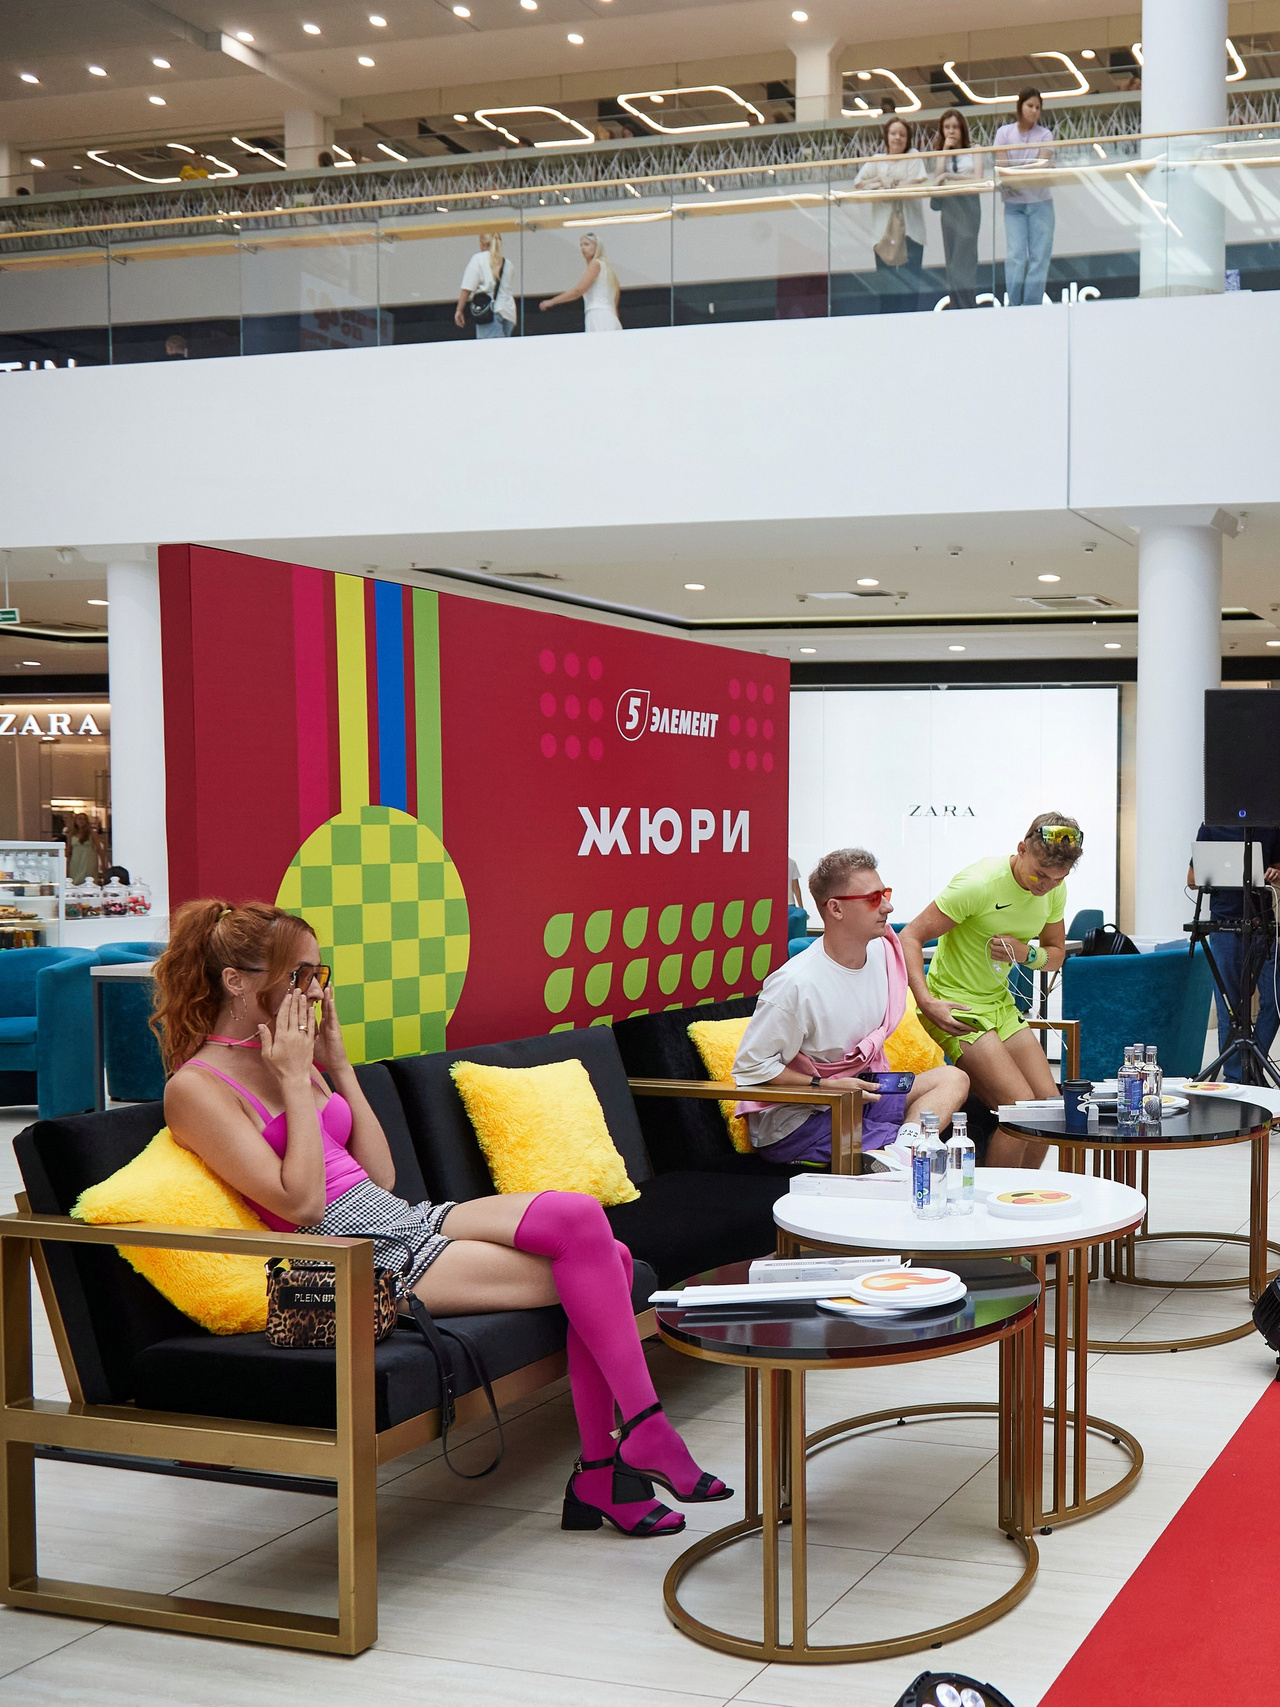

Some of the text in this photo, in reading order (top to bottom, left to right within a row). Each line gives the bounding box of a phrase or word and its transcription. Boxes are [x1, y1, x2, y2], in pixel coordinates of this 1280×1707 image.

[0, 713, 102, 735] ZARA
[626, 697, 719, 738] 5 ЭЛЕМЕНТ
[909, 805, 977, 817] ZARA
[577, 806, 750, 856] ЖЮРИ
[294, 1293, 321, 1303] PLEIN
